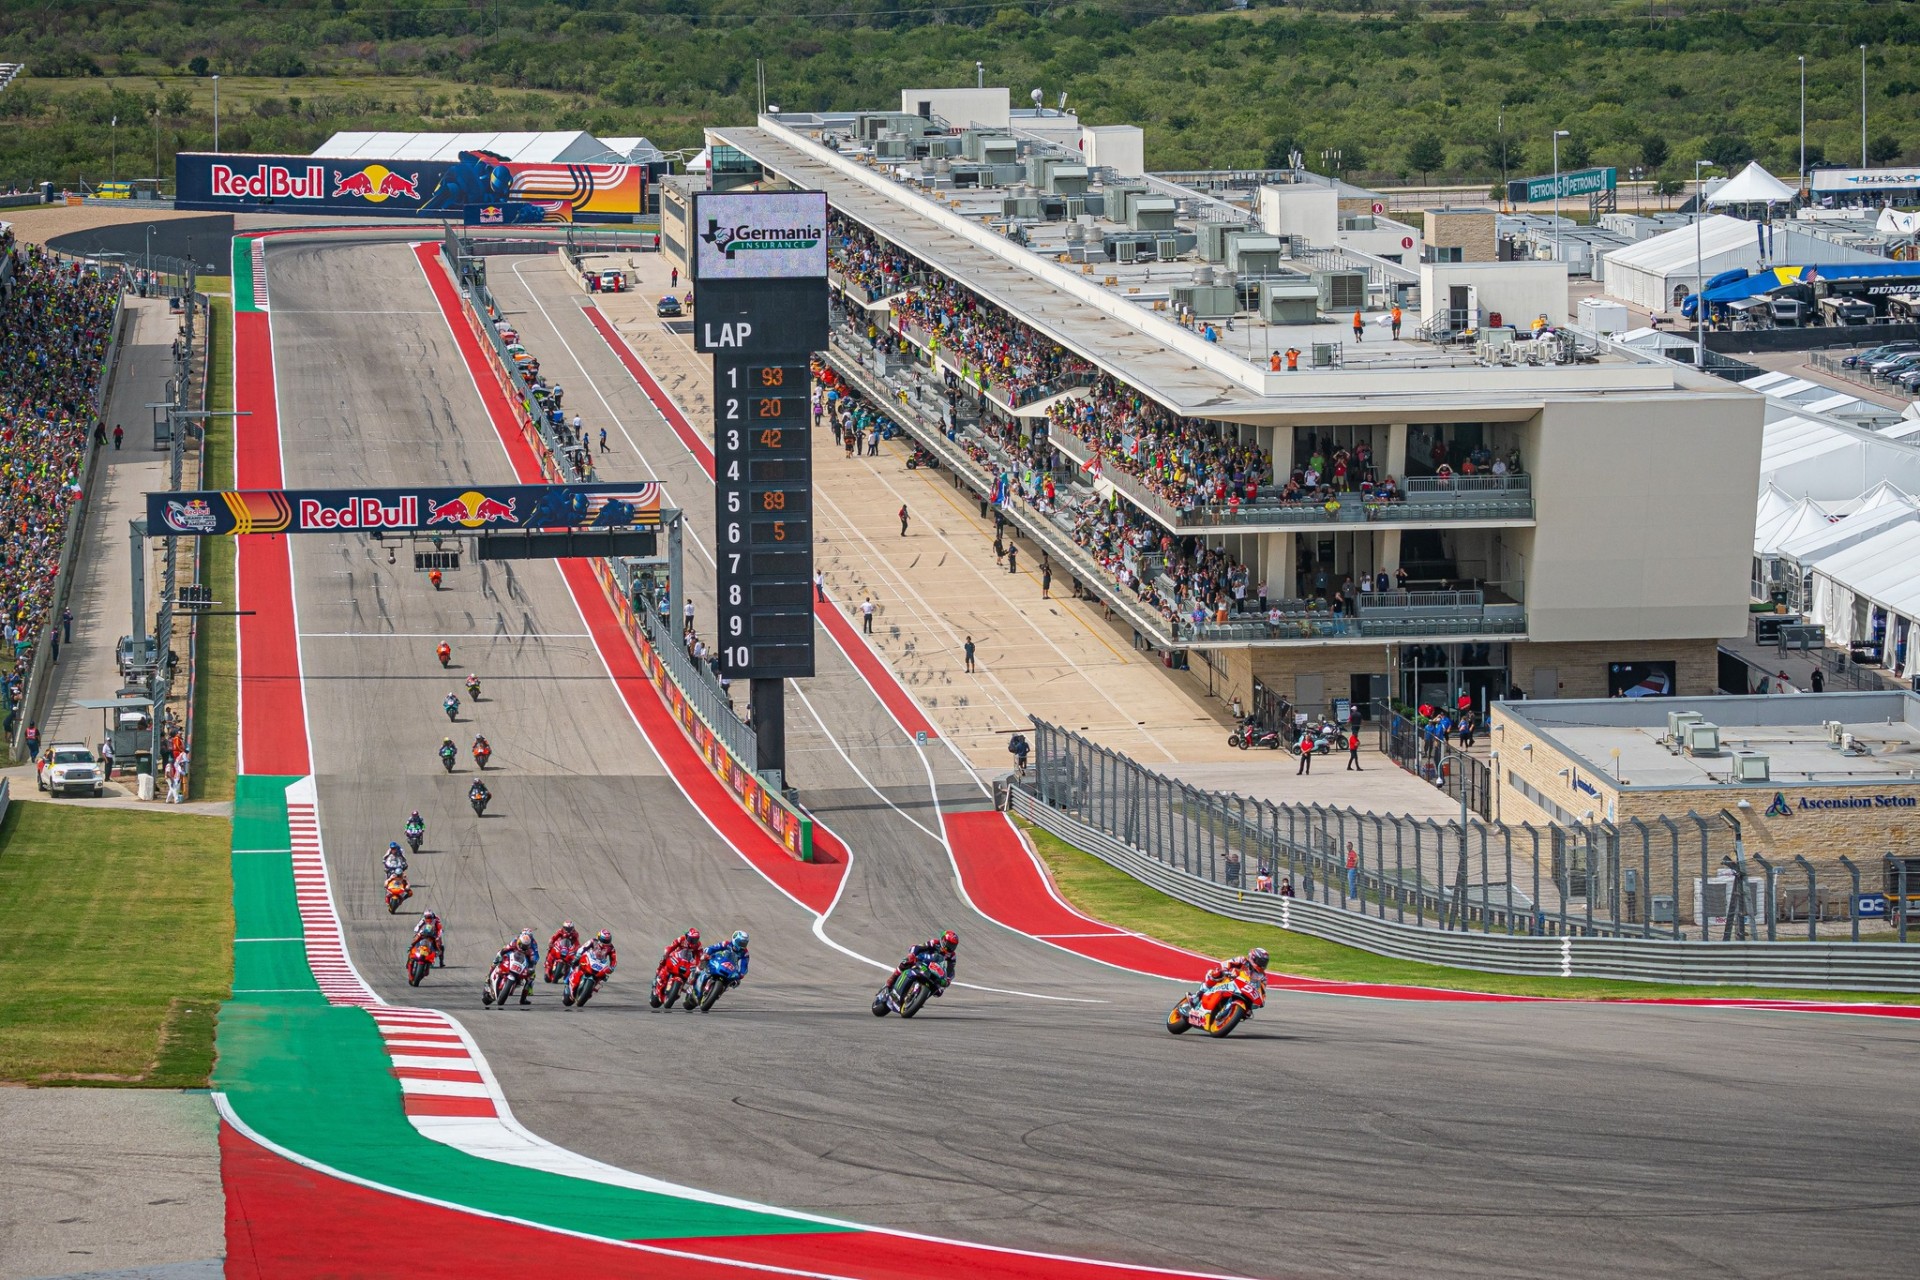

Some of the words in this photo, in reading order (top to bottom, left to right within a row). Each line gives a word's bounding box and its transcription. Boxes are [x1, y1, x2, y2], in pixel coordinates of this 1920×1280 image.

[213, 166, 266, 195] Red
[271, 166, 323, 198] Bull
[1531, 181, 1562, 198] PETRONS
[1569, 175, 1600, 192] PETRONAS
[736, 225, 821, 240] Germania
[705, 323, 751, 348] LAP
[727, 368, 736, 388] 1
[762, 368, 783, 386] 93
[726, 399, 738, 419] 2
[760, 400, 781, 417] 20
[727, 430, 739, 450] 3
[760, 429, 781, 448] 42
[727, 461, 740, 480] 4
[197, 507, 210, 515] Bull
[728, 492, 740, 512] 5
[764, 491, 785, 510] 89
[301, 498, 358, 528] Red
[362, 496, 417, 527] Bull
[728, 523, 740, 543] 6
[774, 522, 785, 540] 5
[728, 554, 741, 574] 7
[729, 585, 741, 605] 8
[730, 616, 742, 636] 9
[724, 646, 749, 667] 10
[1798, 796, 1872, 809] Ascension
[1875, 795, 1916, 807] Seton
[1241, 983, 1260, 1000] 93
